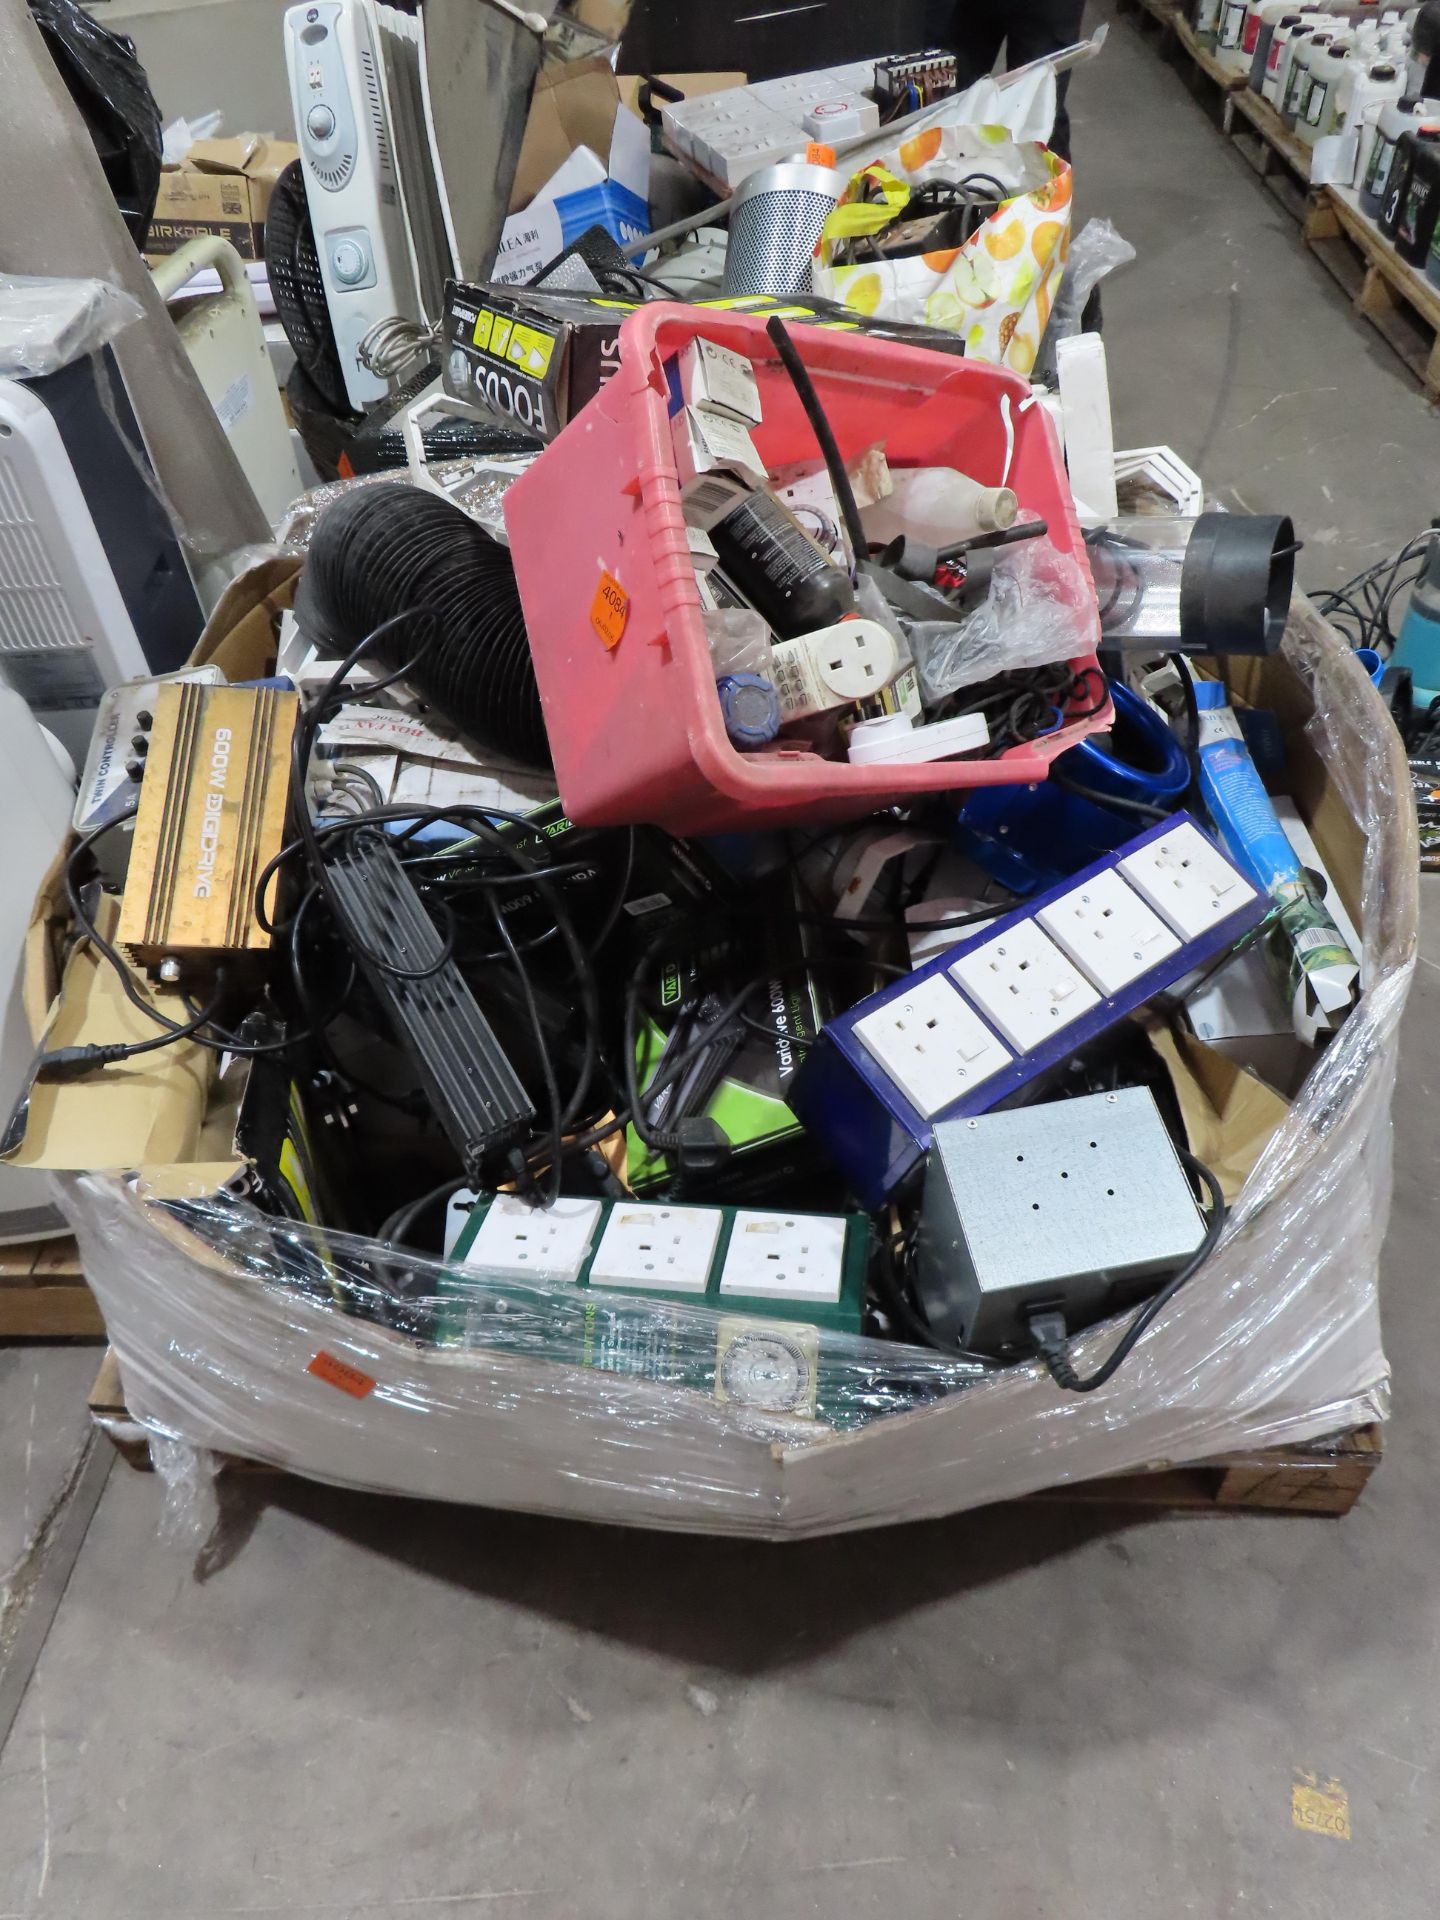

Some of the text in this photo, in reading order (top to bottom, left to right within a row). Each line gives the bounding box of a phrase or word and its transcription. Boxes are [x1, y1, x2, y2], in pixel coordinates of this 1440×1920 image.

[1384, 189, 1400, 224] 3
[474, 365, 548, 435] FOCUS
[602, 586, 625, 620] 4084
[91, 712, 122, 805] TWIN CONTROLLER
[210, 727, 232, 789] 600W
